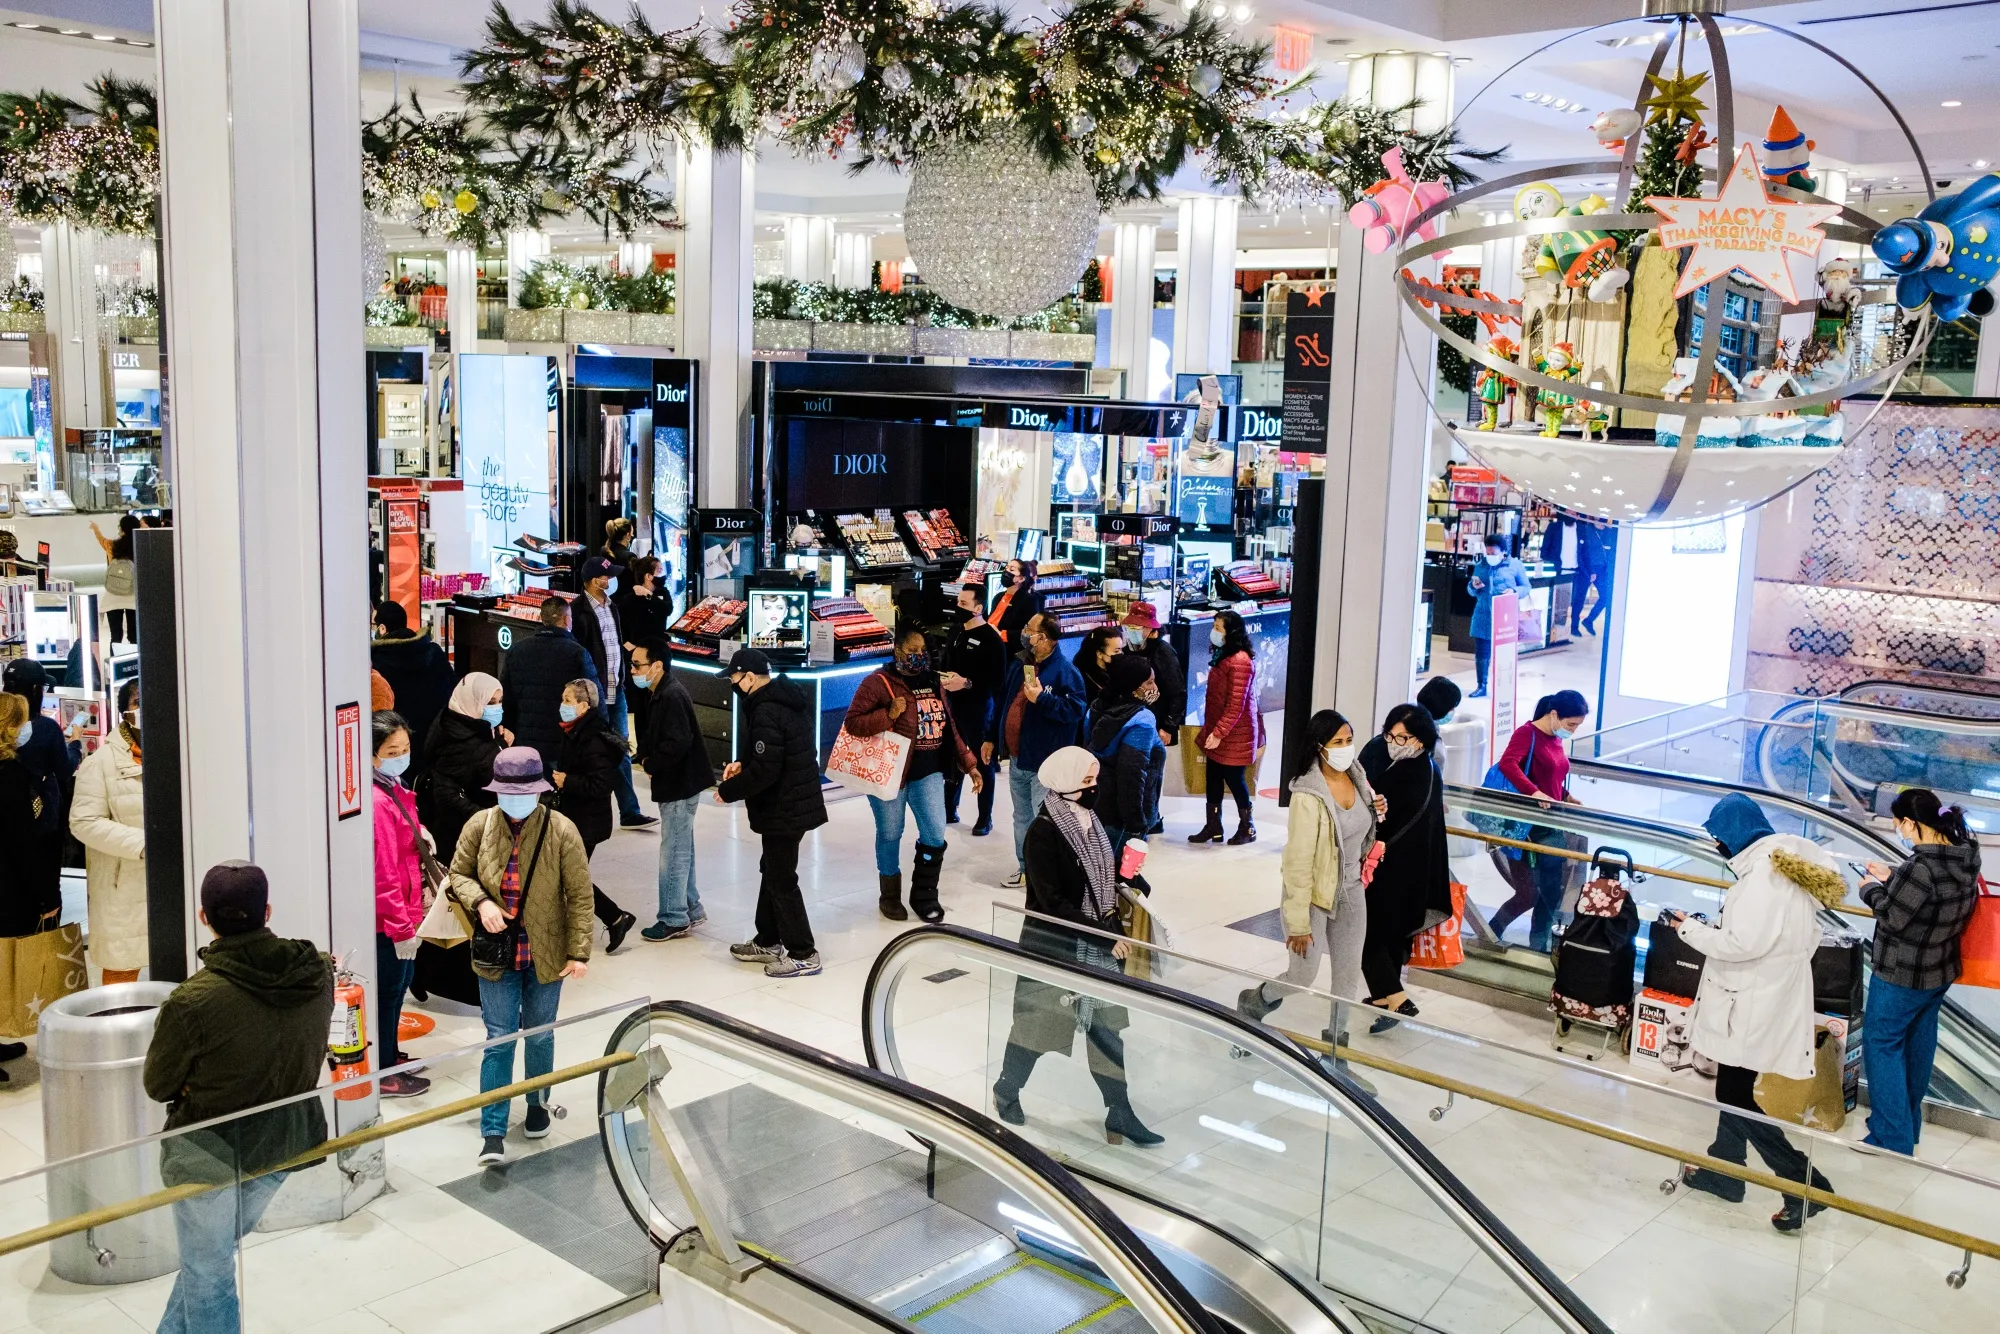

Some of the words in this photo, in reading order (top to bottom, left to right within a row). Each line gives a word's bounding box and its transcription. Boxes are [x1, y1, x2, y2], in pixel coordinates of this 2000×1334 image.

[1665, 226, 1783, 243] THANKSGIVING
[1787, 232, 1817, 249] DAY
[1714, 239, 1766, 252] PARADE
[656, 384, 687, 402] Dior
[1010, 408, 1048, 427] Dior
[482, 456, 500, 476] the
[833, 453, 888, 475] DIOR
[481, 477, 529, 509] beauty
[481, 500, 517, 522] store
[715, 517, 746, 529] Dior
[1152, 521, 1171, 532] Dior
[337, 708, 358, 724] FIRE
[1676, 960, 1699, 970] EXPRESS
[1640, 1005, 1664, 1018] Tools
[1639, 1022, 1658, 1050] 13
